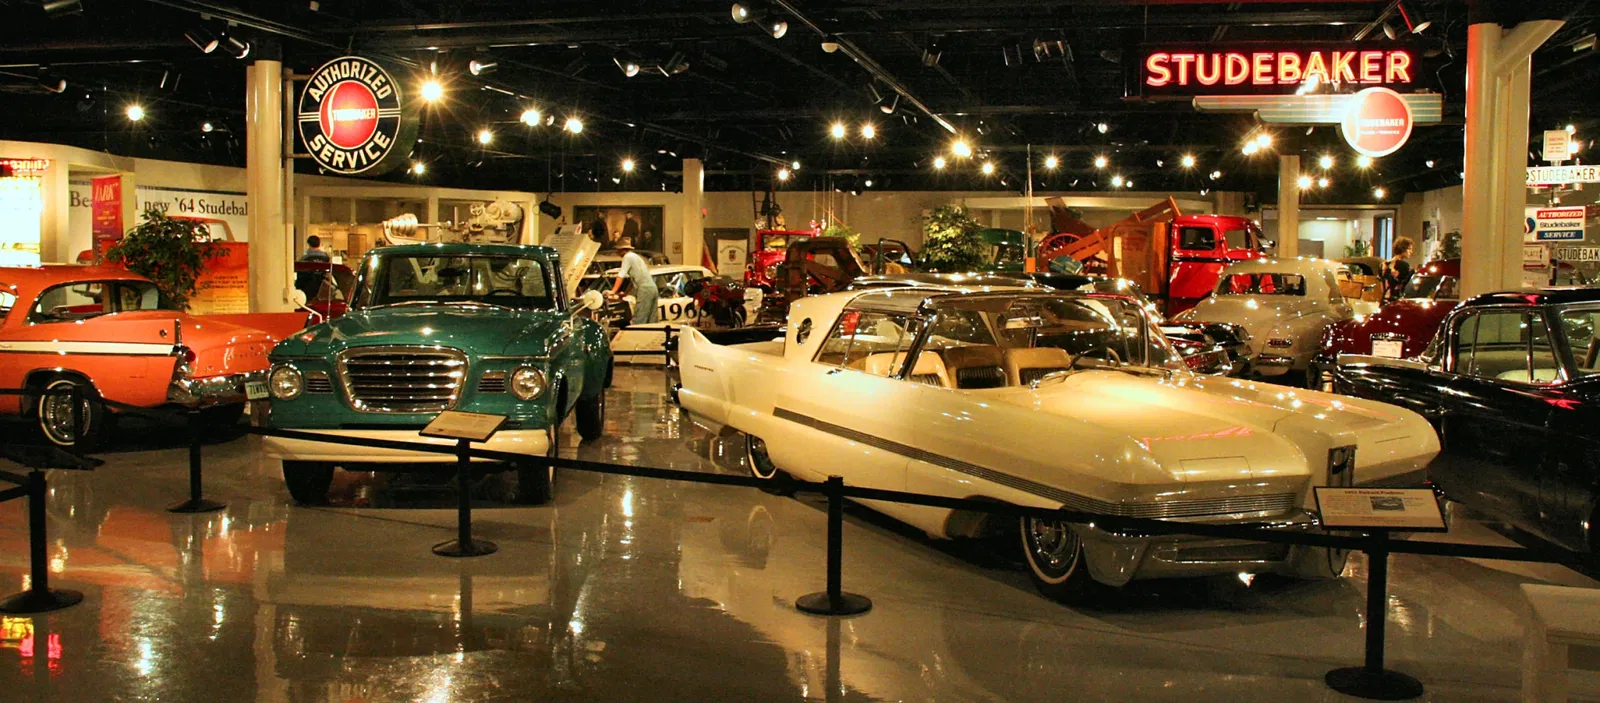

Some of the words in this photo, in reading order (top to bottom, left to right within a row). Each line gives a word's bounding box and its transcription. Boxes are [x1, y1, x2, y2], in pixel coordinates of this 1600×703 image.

[308, 61, 392, 102] AUTHORIZED
[1145, 51, 1411, 87] STUDEBAKER
[309, 130, 391, 169] SERVICE
[1530, 168, 1595, 182] STUDEBAKER
[144, 200, 171, 212] new
[175, 196, 195, 213] '64
[1557, 248, 1600, 260] STUDEBAK
